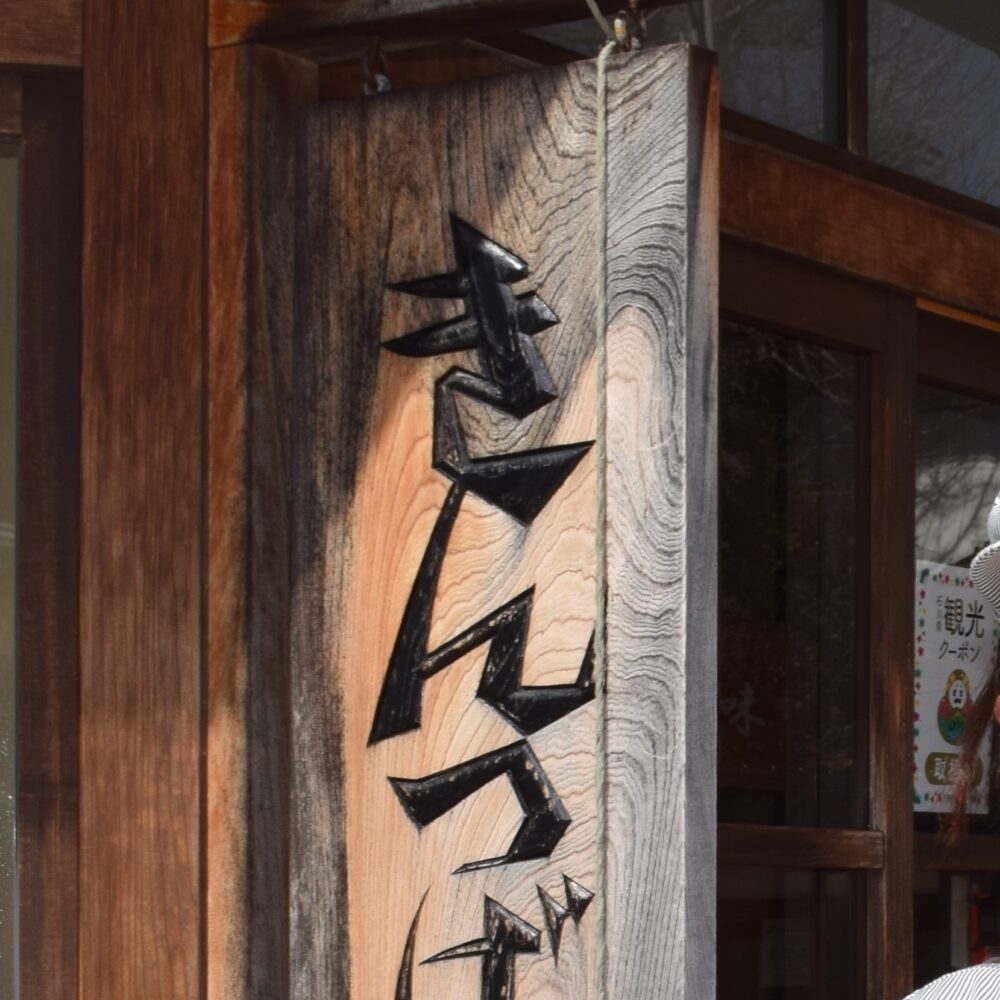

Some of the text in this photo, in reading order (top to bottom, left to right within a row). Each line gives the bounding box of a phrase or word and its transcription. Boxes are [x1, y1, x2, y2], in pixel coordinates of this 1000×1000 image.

[943, 596, 985, 639] 観光
[937, 639, 981, 663] クーポン
